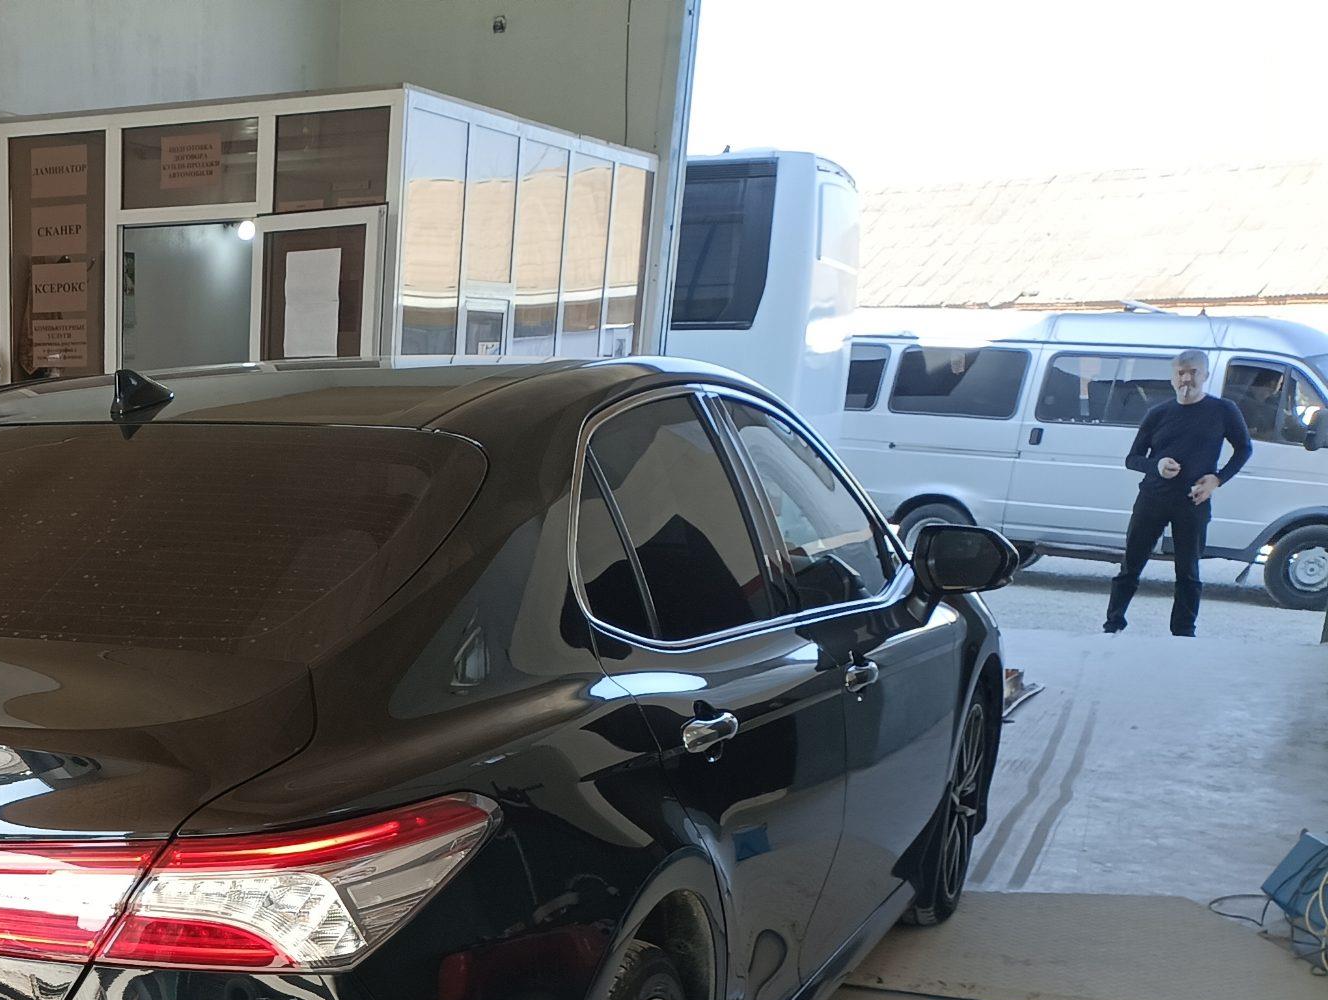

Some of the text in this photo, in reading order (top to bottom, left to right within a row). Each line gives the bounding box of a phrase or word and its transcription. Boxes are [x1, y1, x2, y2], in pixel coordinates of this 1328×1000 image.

[32, 163, 87, 177] ЛАМИНАТОР
[37, 223, 82, 238] СКАНЕР
[34, 281, 86, 295] КСЕРОКС
